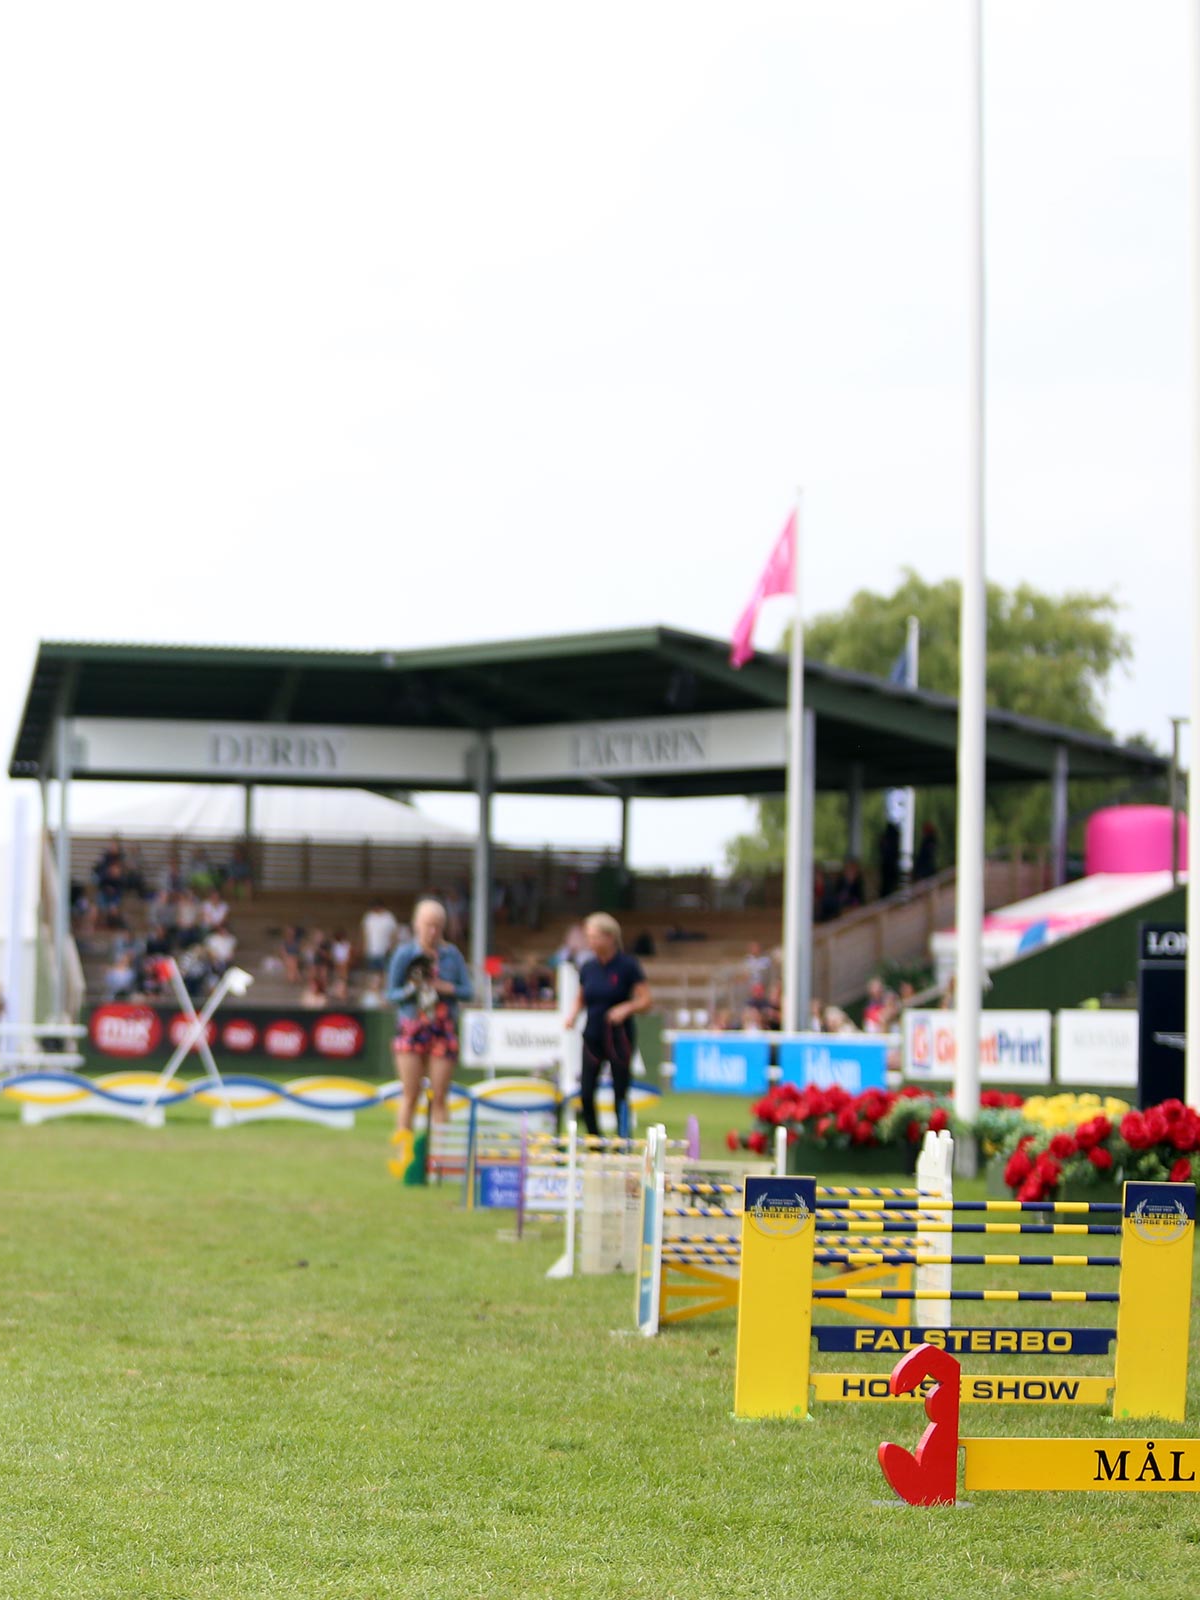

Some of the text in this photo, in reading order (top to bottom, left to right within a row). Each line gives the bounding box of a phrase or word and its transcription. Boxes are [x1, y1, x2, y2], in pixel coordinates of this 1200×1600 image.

[210, 734, 344, 769] DERBY
[934, 1027, 1043, 1064] GintPrint
[855, 1330, 1073, 1352] FALSTERBO
[842, 1378, 1080, 1400] HOS SHOW
[1093, 1441, 1196, 1482] MÅL
